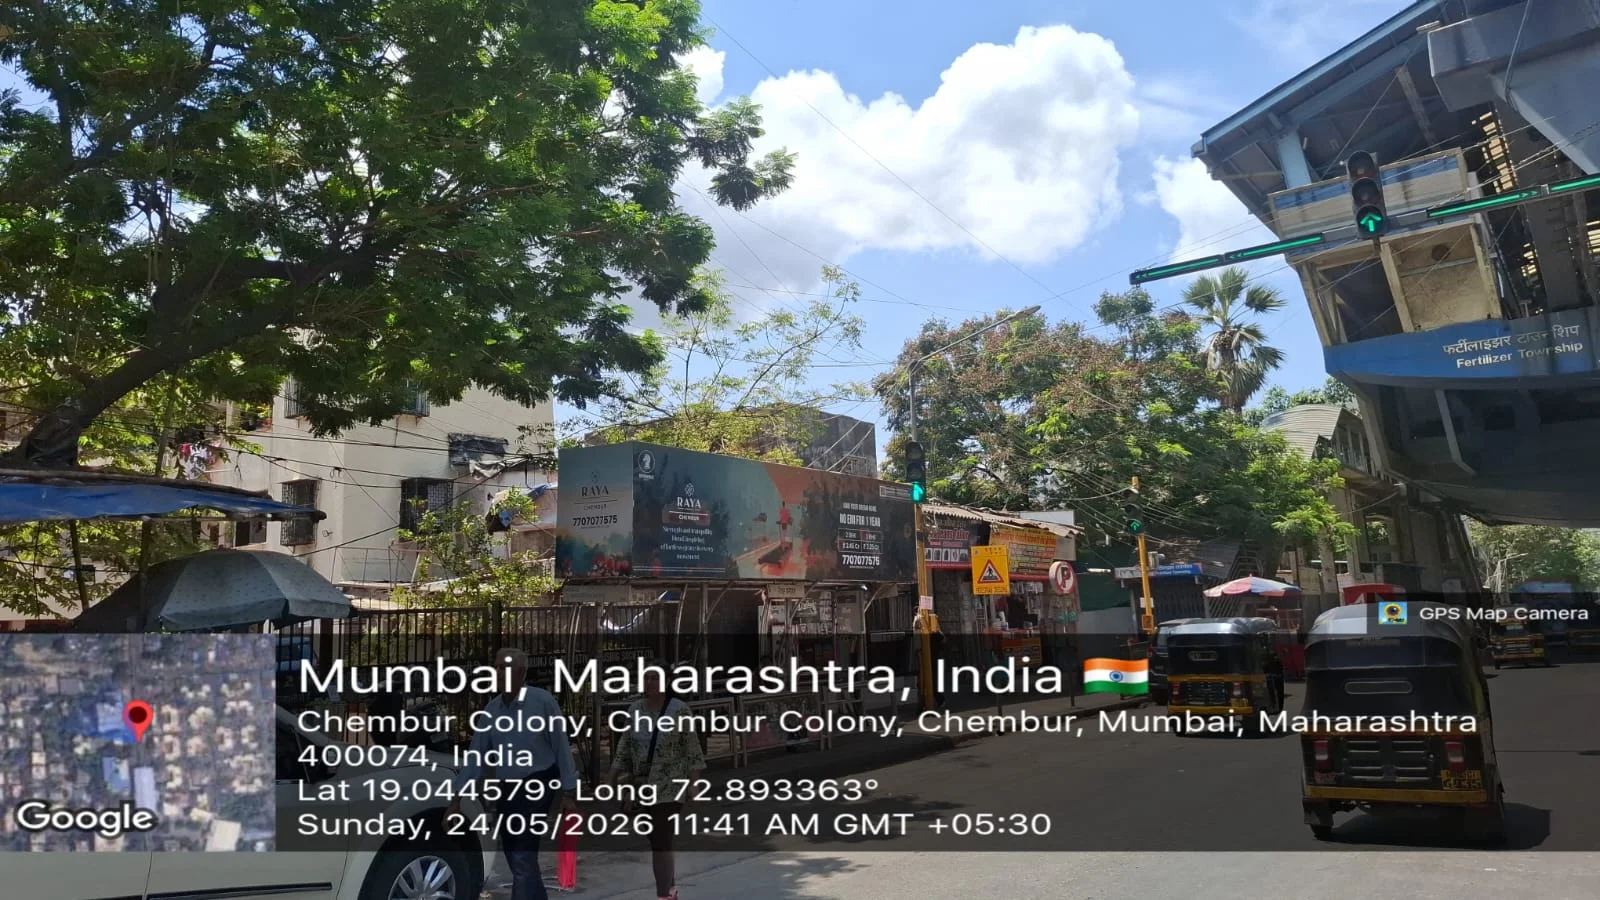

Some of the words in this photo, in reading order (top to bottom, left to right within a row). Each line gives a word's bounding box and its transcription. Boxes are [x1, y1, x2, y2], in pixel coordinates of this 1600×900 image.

[1456, 352, 1513, 368] Fertilizer
[1517, 342, 1583, 359] Township
[581, 485, 609, 497] RAYA
[676, 496, 702, 510] RAYA
[572, 514, 618, 527] 7707077575
[842, 554, 881, 566] 7707077575
